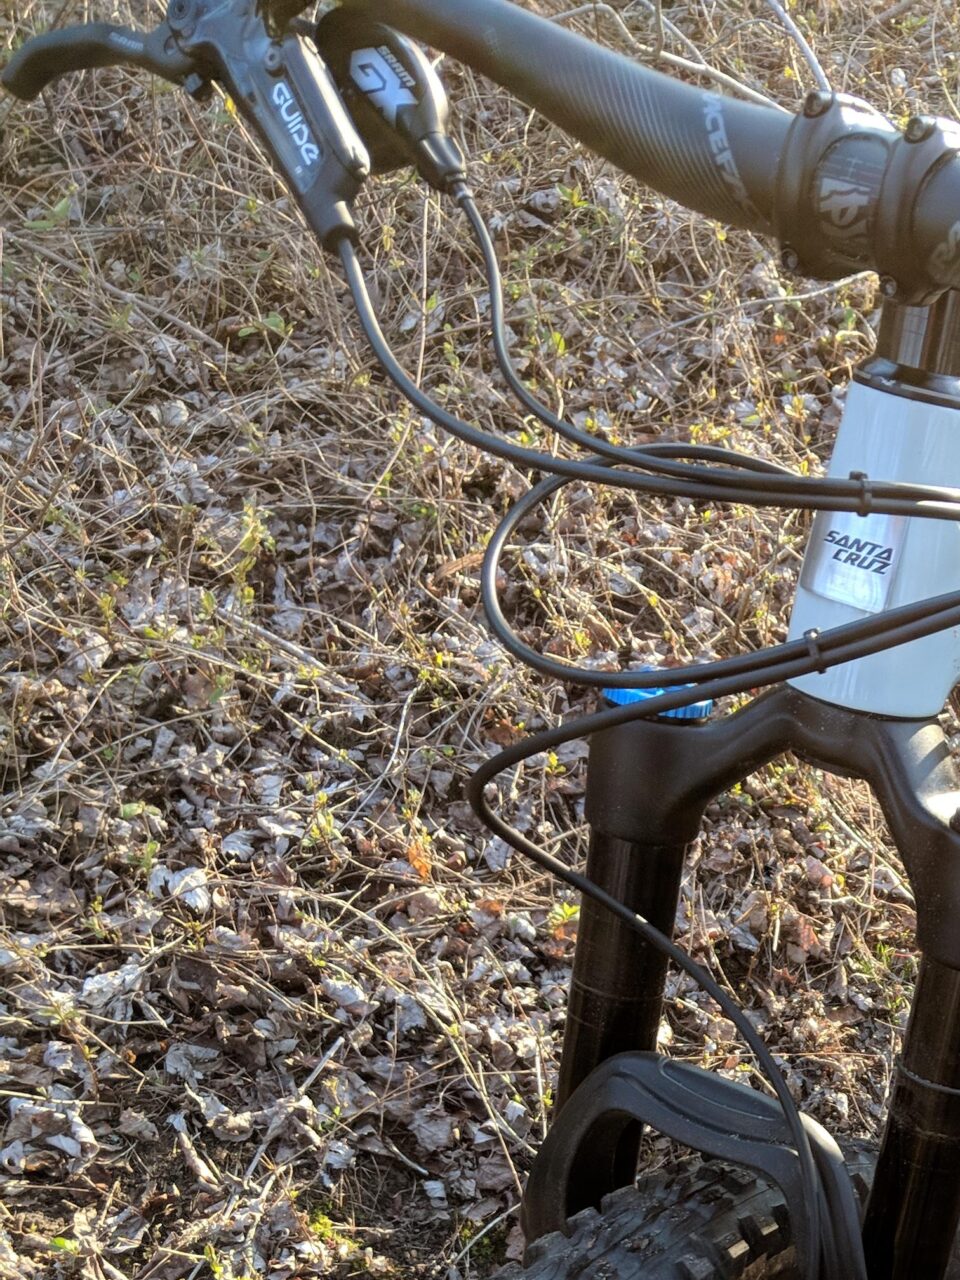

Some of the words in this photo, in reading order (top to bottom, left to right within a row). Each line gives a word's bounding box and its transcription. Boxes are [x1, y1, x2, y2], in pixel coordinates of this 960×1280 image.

[375, 45, 416, 87] SRAM
[272, 82, 320, 166] GUIDE
[823, 530, 894, 562] SANTA
[832, 548, 893, 575] CRUZ
